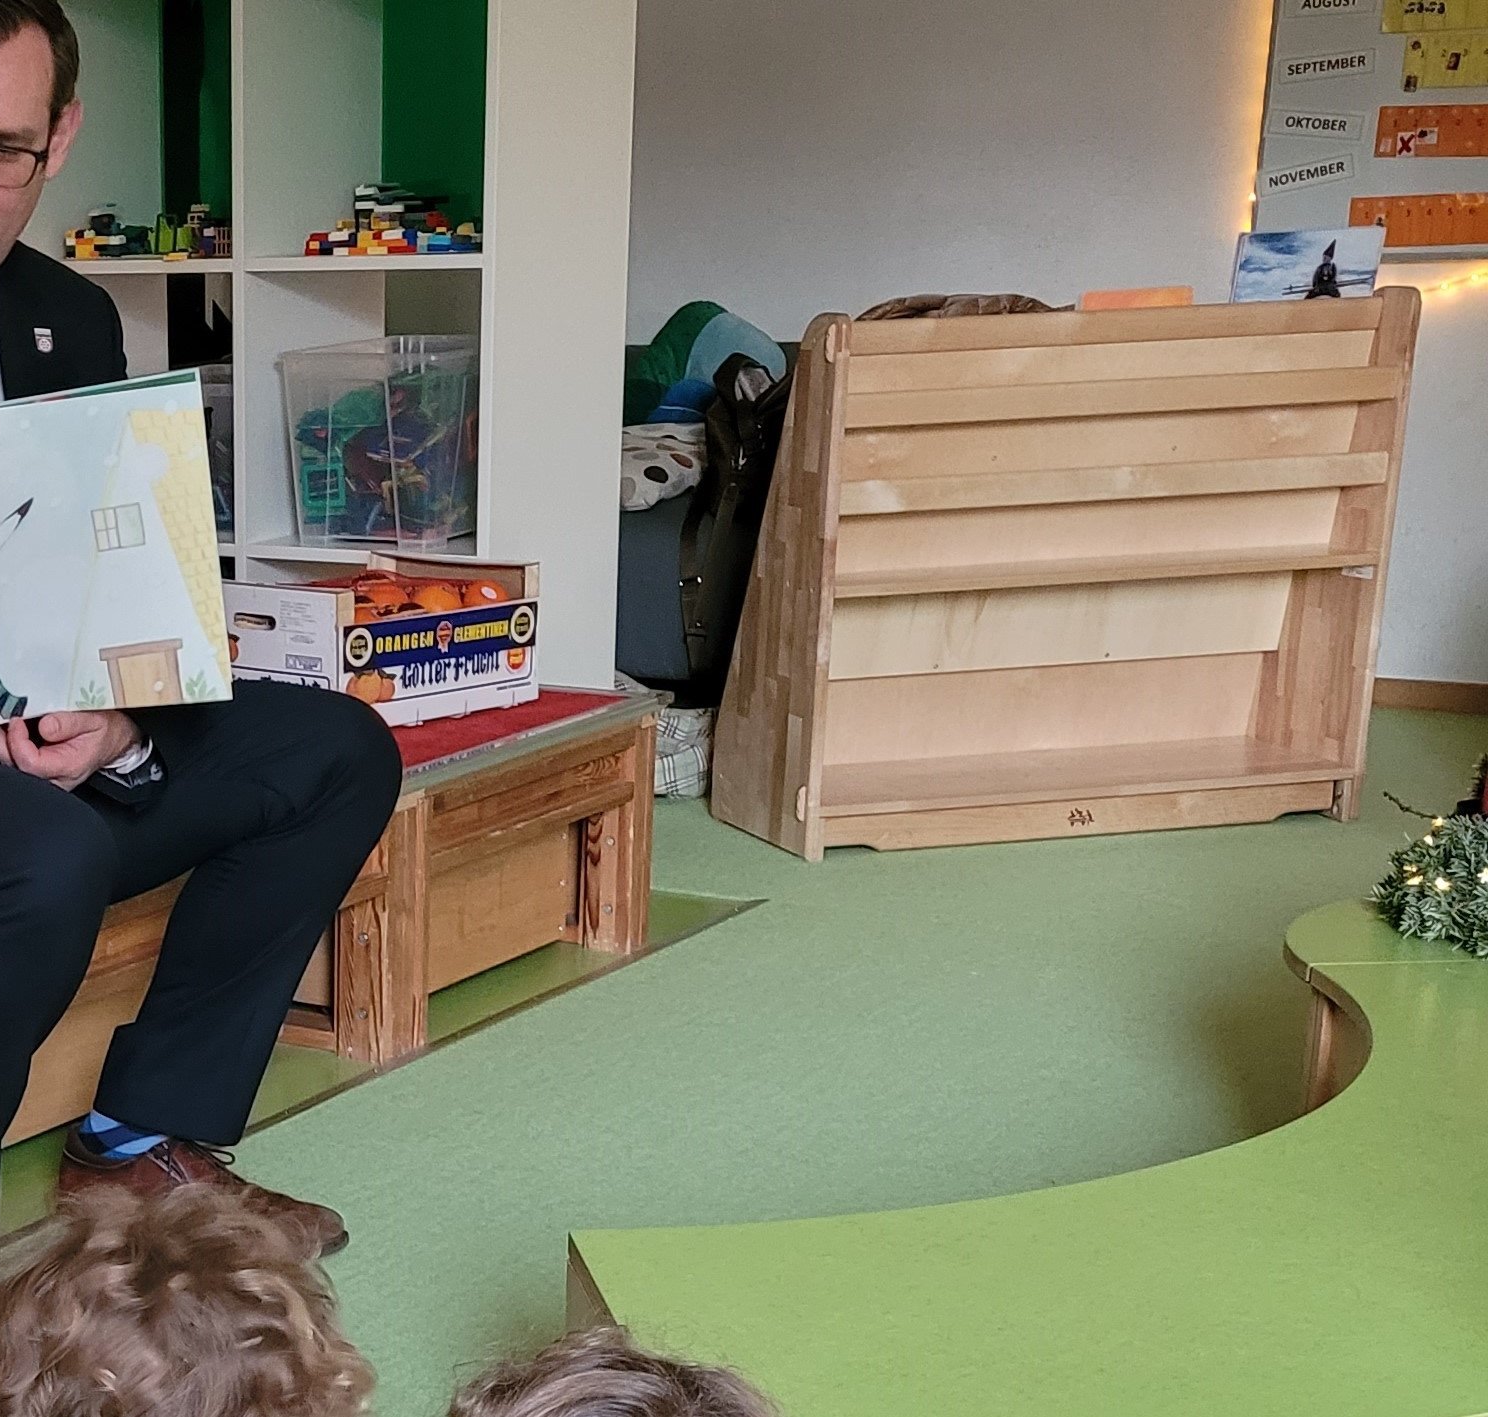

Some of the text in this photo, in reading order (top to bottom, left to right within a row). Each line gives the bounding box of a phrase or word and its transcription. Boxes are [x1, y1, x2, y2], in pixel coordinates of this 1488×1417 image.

[1287, 55, 1366, 76] SEPTEMBER
[1285, 116, 1347, 132] OKTOBER
[1268, 161, 1345, 188] NOVEMBER
[375, 630, 434, 655] ORANGEN
